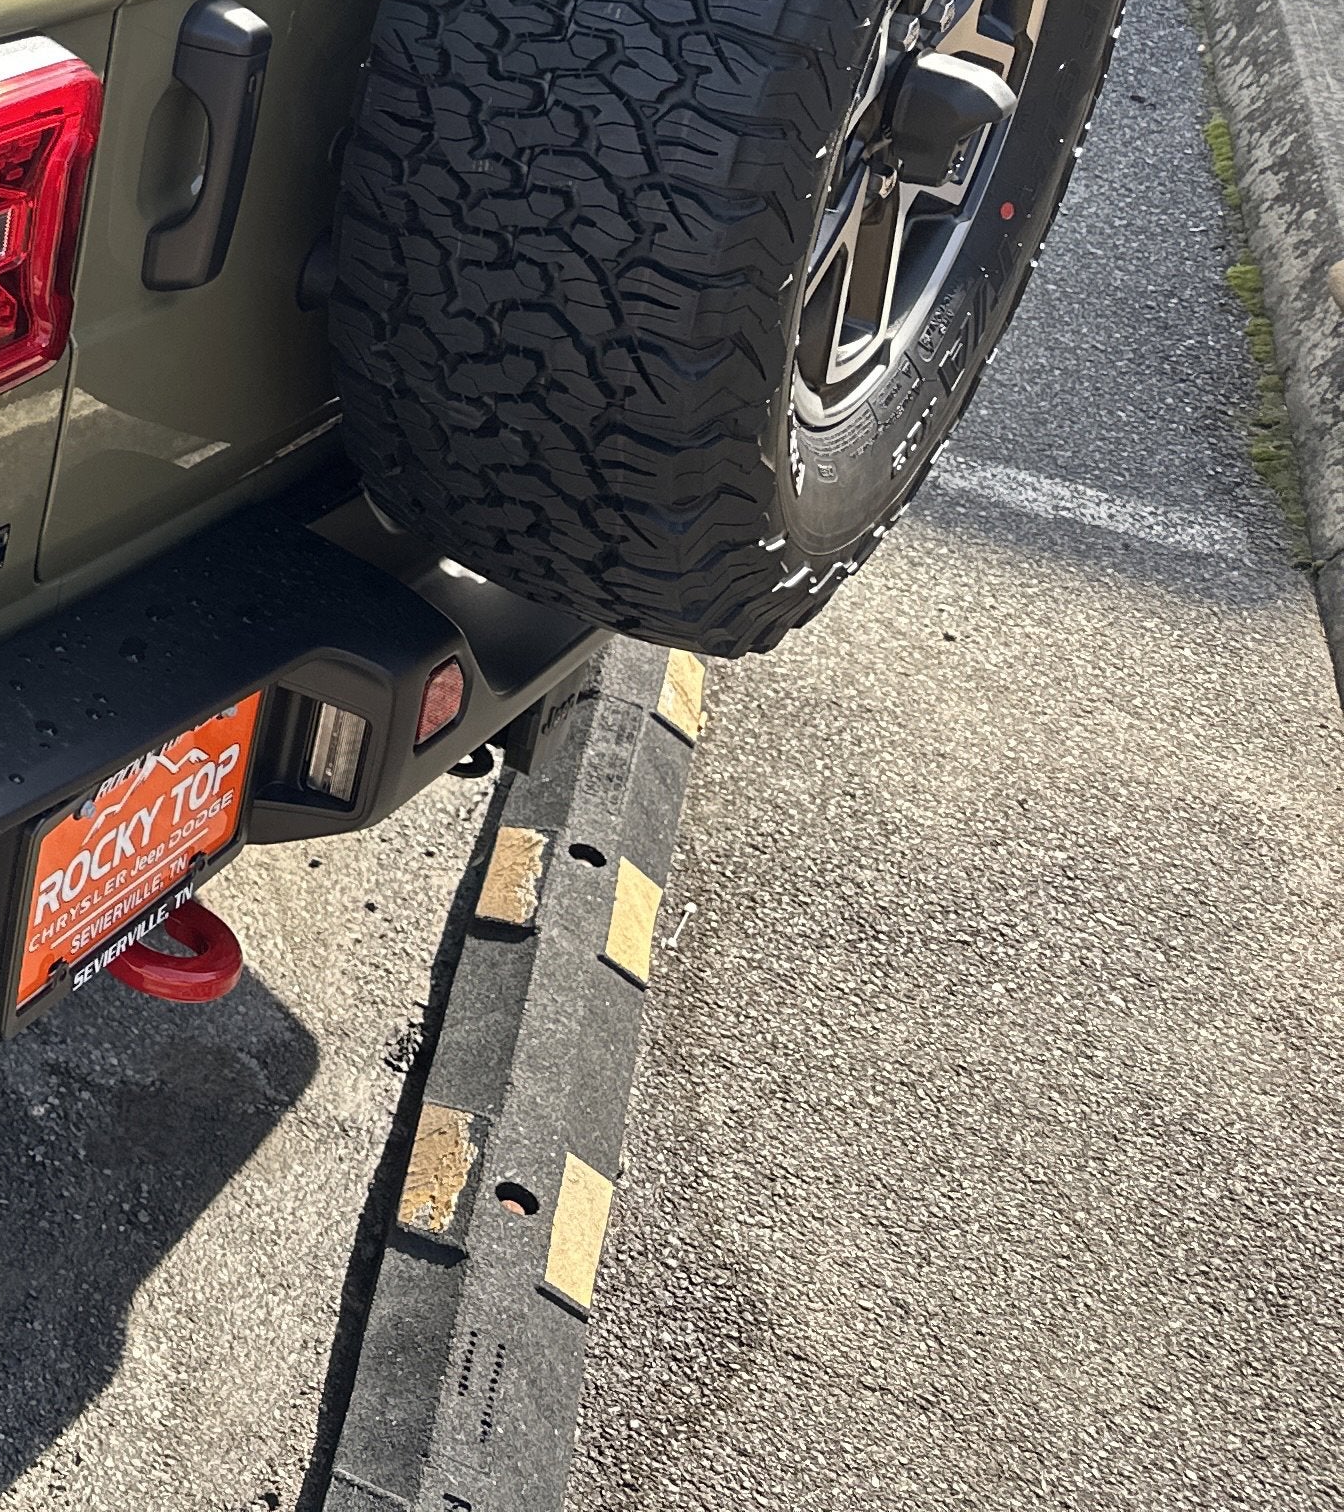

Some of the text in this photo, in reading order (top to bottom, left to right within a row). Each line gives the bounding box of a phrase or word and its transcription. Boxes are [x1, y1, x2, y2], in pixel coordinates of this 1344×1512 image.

[28, 788, 234, 953] CHRYSLER Jeep DODGE
[33, 794, 167, 926] ROCKY
[170, 743, 241, 825] TOP
[169, 852, 189, 880] TN
[174, 882, 195, 911] TN
